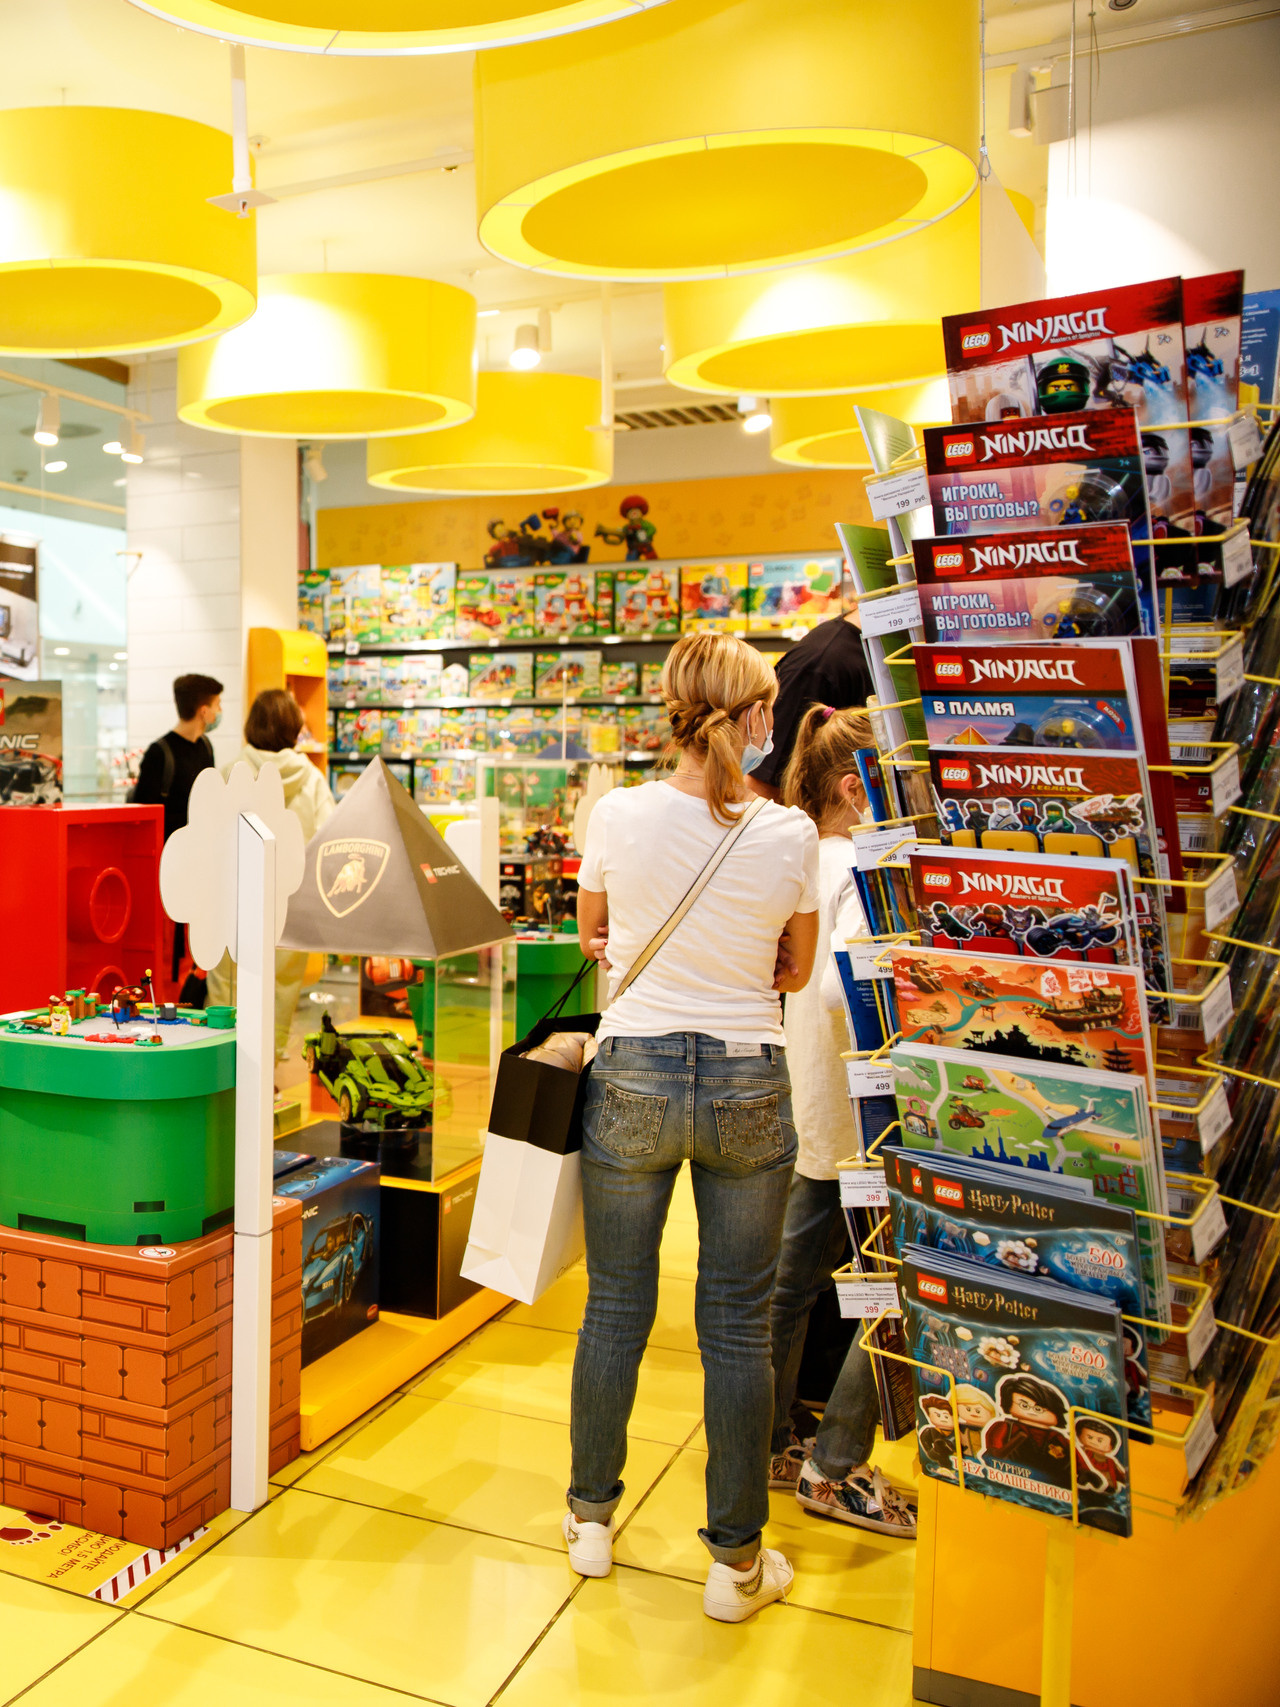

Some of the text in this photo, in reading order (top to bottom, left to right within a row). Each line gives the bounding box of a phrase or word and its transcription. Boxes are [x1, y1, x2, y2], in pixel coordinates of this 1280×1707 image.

[962, 307, 1115, 352] LEGO NINJAGO
[946, 443, 973, 457] LEGO
[979, 424, 1097, 462] NINJAGO
[896, 499, 910, 508] 199
[942, 483, 1005, 502] ИГРОКИ,
[945, 501, 1040, 522] ВЫ ГОТОВЫ?
[935, 540, 1088, 573] LEGO NINJAGO
[932, 594, 996, 611] ИГРОКИ,
[888, 619, 903, 627] 199
[935, 612, 1032, 630] ВЫ ГОТОВЫ?
[936, 659, 1086, 686] LEGO NINJAGO
[933, 701, 1016, 716] В ПЛАМЯ
[942, 764, 1094, 793] LEGO NINJAGO
[324, 843, 383, 858] LAMBORGHINI
[923, 871, 1073, 904] LEGO NINJAGO
[934, 1185, 1055, 1222] LEGO Harry Potter
[1088, 1246, 1125, 1270] 500
[918, 1280, 1038, 1319] LEGO Harry Potter
[1071, 1346, 1106, 1370] 500
[991, 1459, 1032, 1478] ТУРНИР
[988, 1469, 1074, 1503] ВОЛШЕБНИКО
[46, 1558, 81, 1578] МЕТРА
